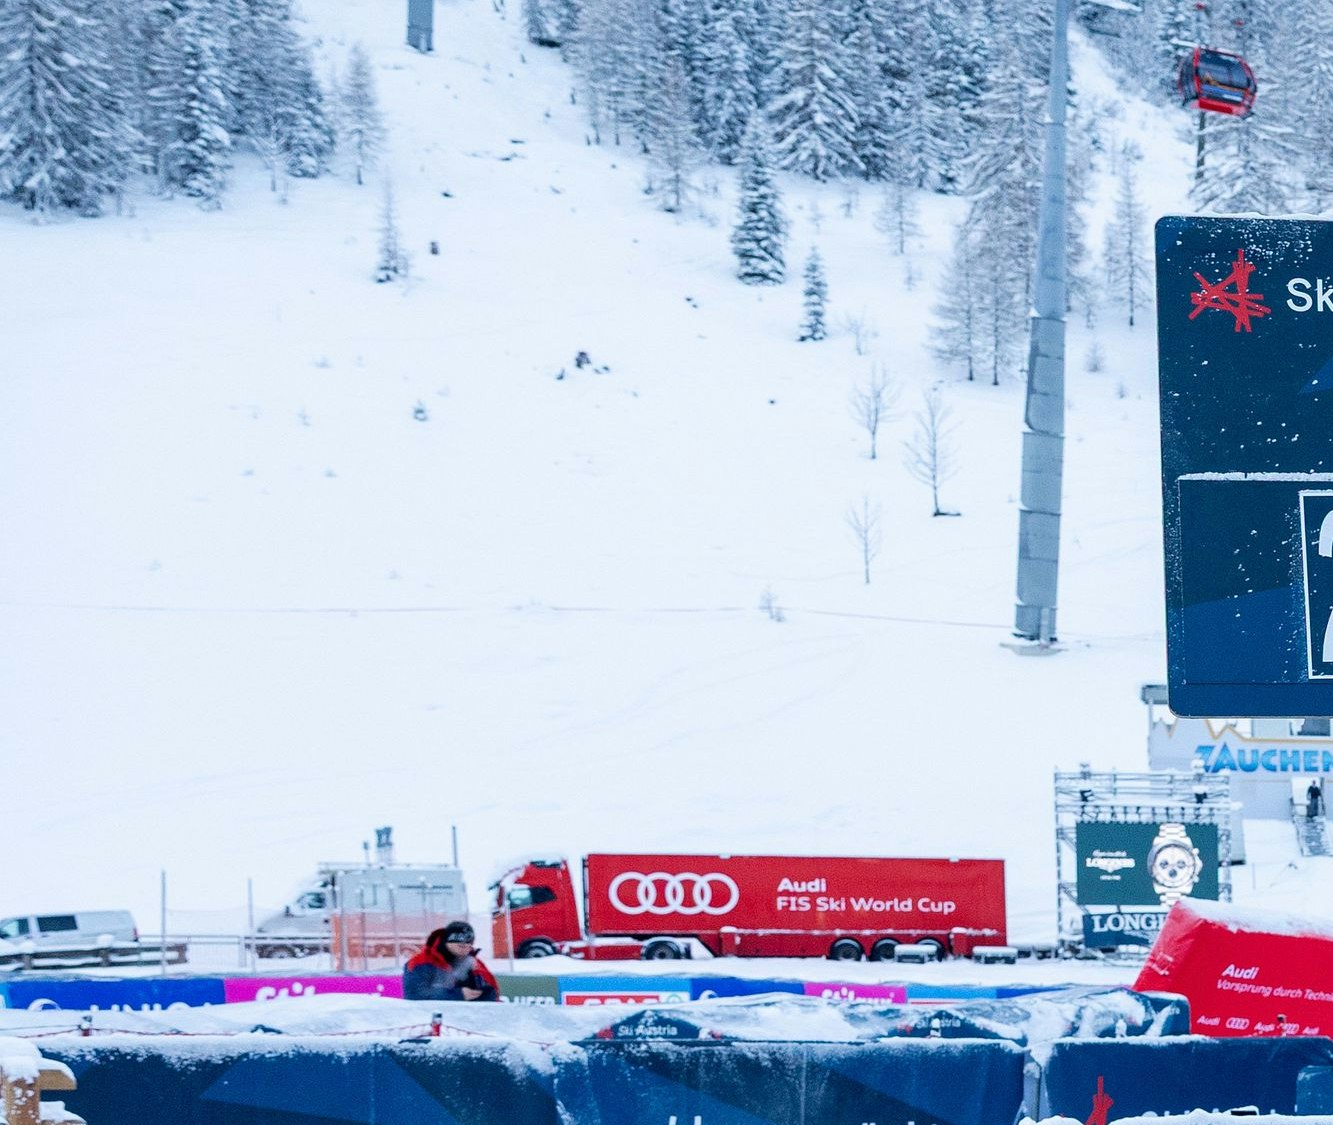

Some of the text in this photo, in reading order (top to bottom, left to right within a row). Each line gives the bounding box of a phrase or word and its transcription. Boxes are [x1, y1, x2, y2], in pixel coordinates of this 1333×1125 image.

[776, 877, 827, 893] Audi
[776, 896, 956, 915] FIS Ski World Cup
[1092, 914, 1166, 932] LONGI
[1221, 963, 1260, 980] Audi
[1217, 979, 1273, 998] Vorsprung
[1273, 986, 1302, 998] durch
